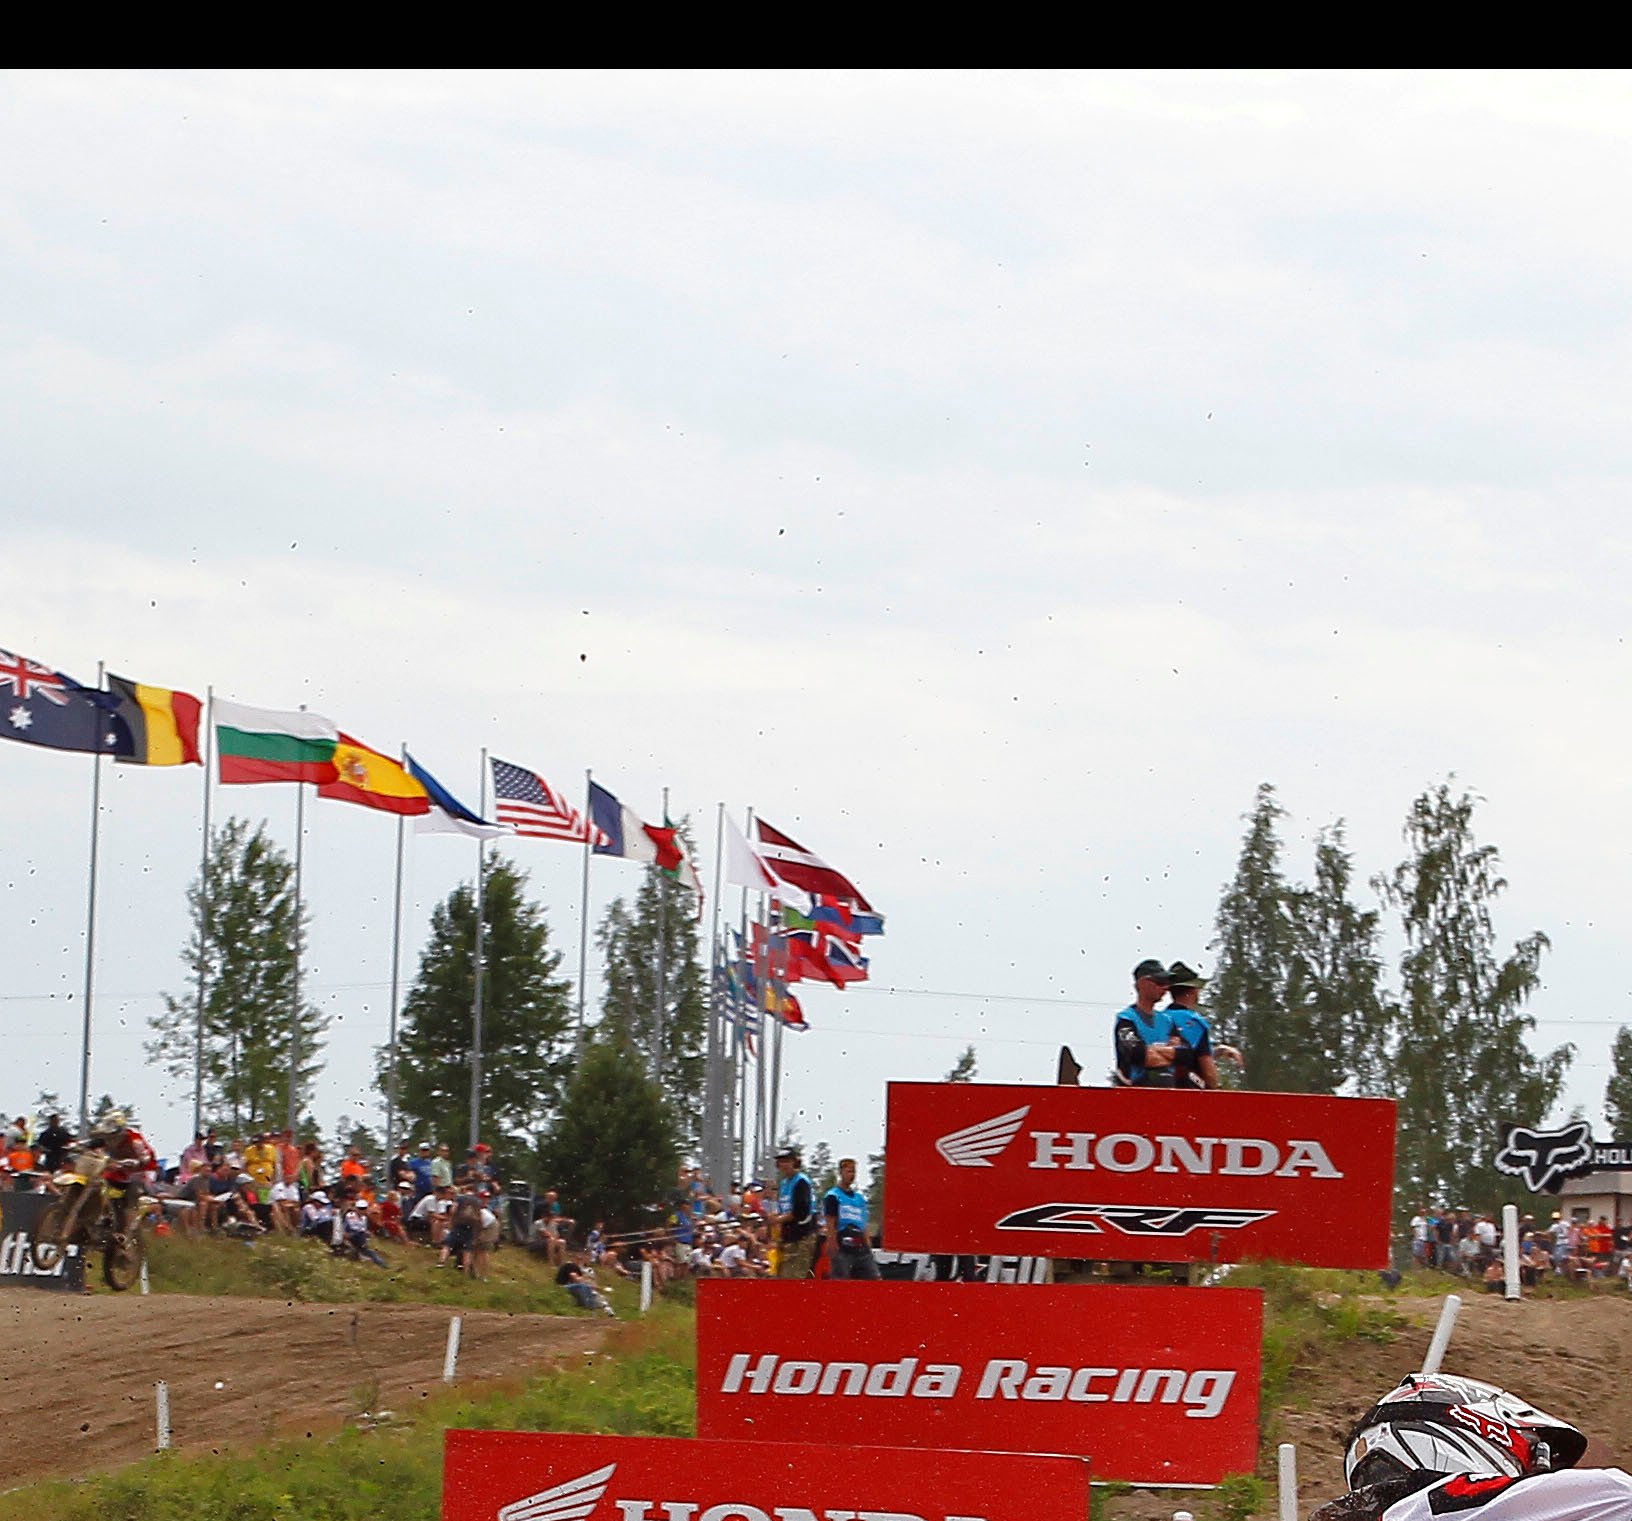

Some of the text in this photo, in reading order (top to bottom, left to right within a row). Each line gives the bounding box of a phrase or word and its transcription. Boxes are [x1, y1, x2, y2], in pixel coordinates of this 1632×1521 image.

[1028, 1131, 1344, 1179] HONDA
[995, 1203, 1279, 1236] CRF
[720, 1353, 1237, 1419] Honda Racing
